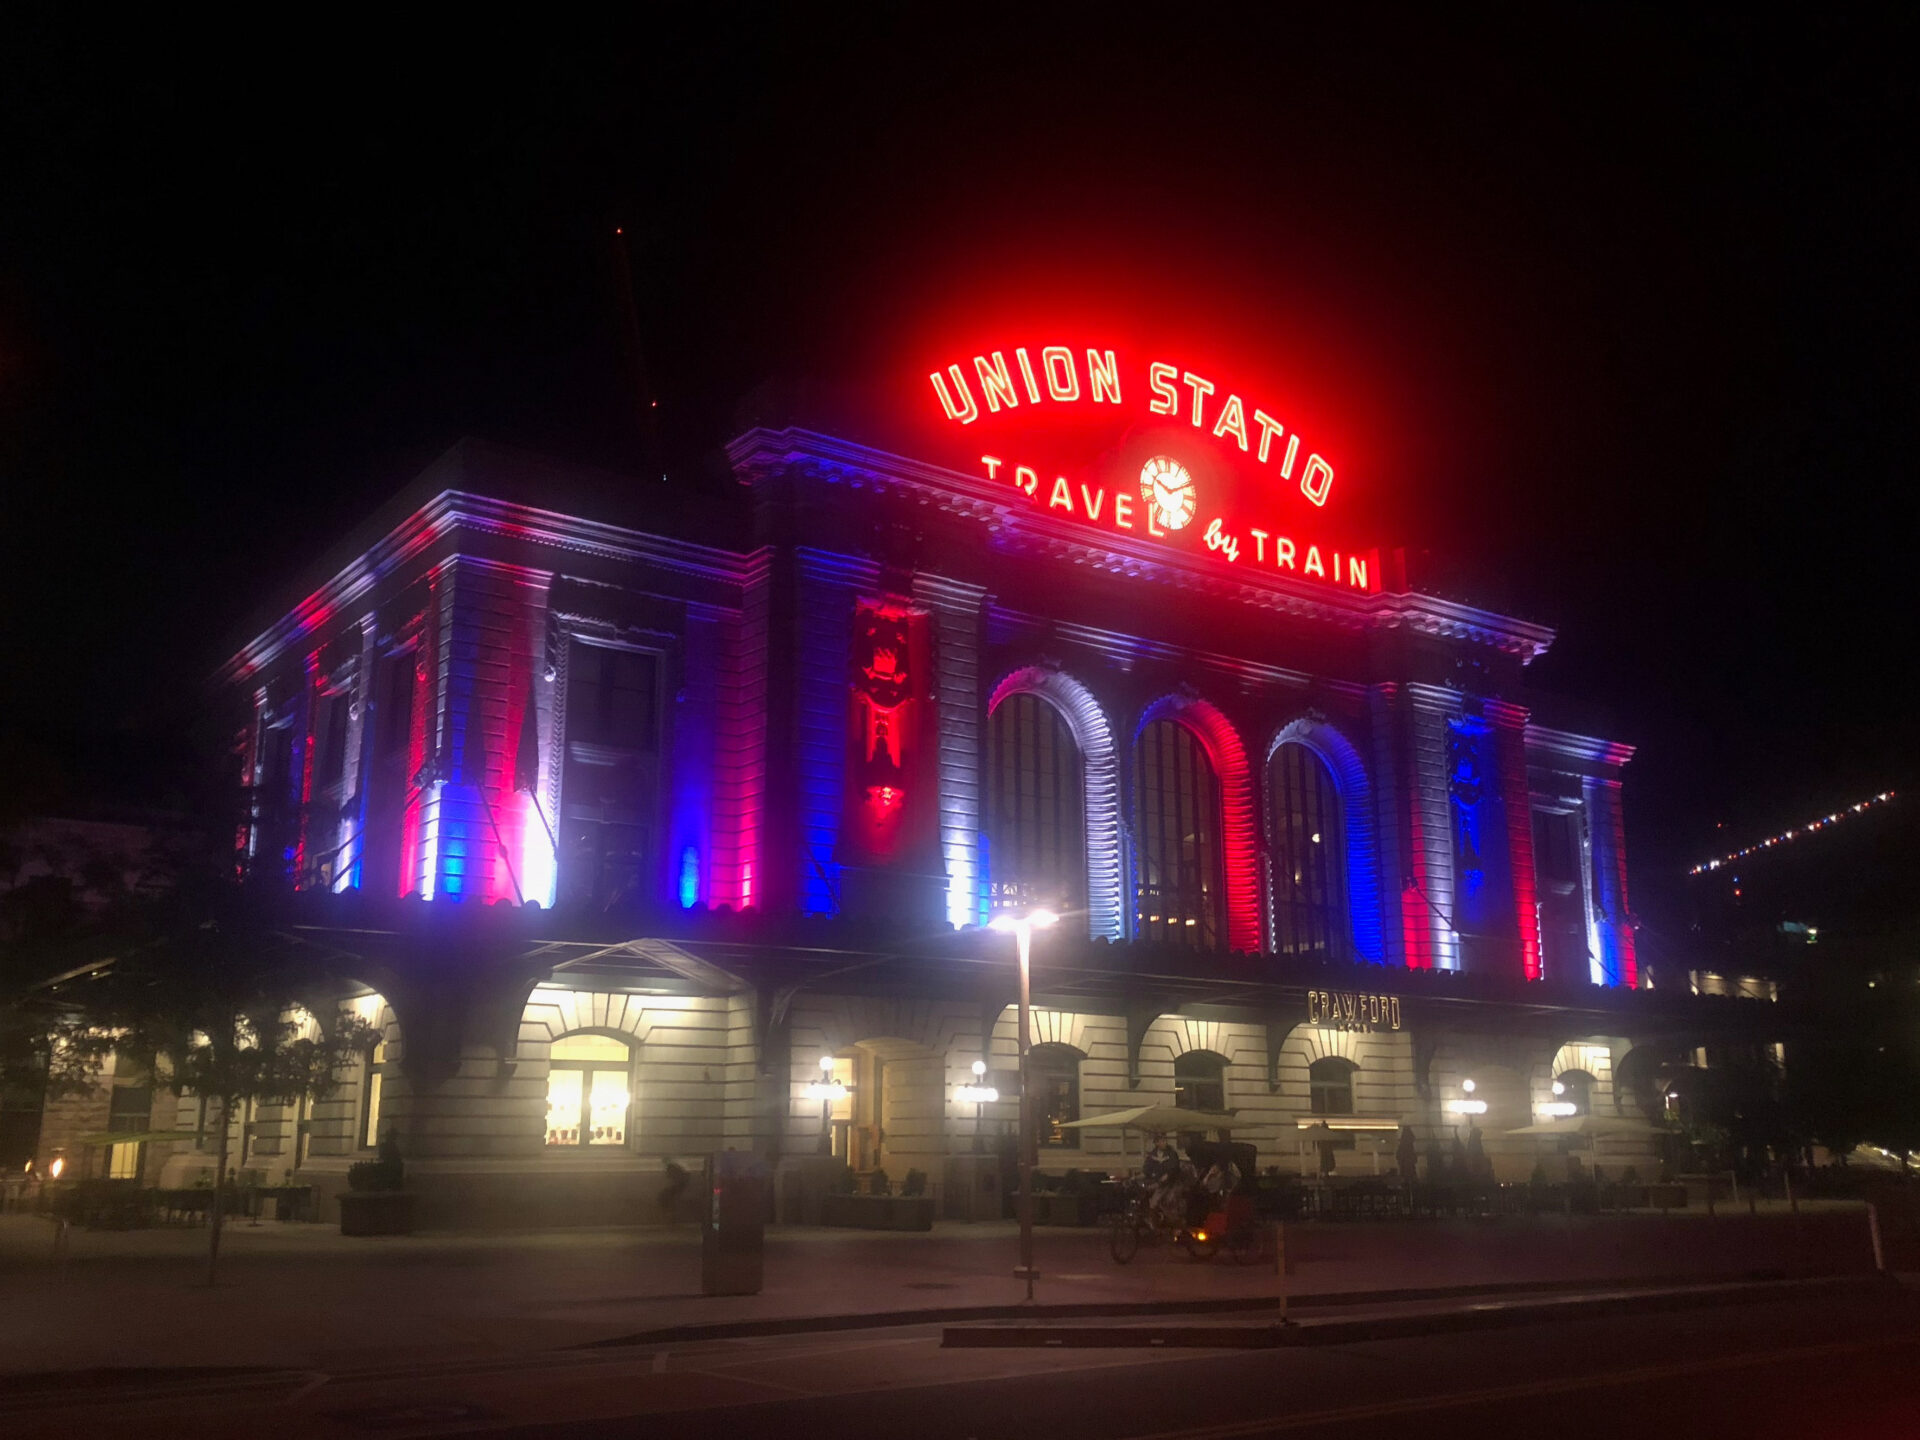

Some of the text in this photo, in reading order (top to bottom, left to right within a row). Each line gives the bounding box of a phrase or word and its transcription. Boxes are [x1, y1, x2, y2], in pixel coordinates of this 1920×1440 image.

[930, 346, 1122, 425] UNION
[981, 455, 1165, 537] TRAVEL
[1203, 517, 1240, 563] by
[1250, 528, 1369, 590] TRAIN
[1307, 990, 1401, 1030] CRAWFORD
